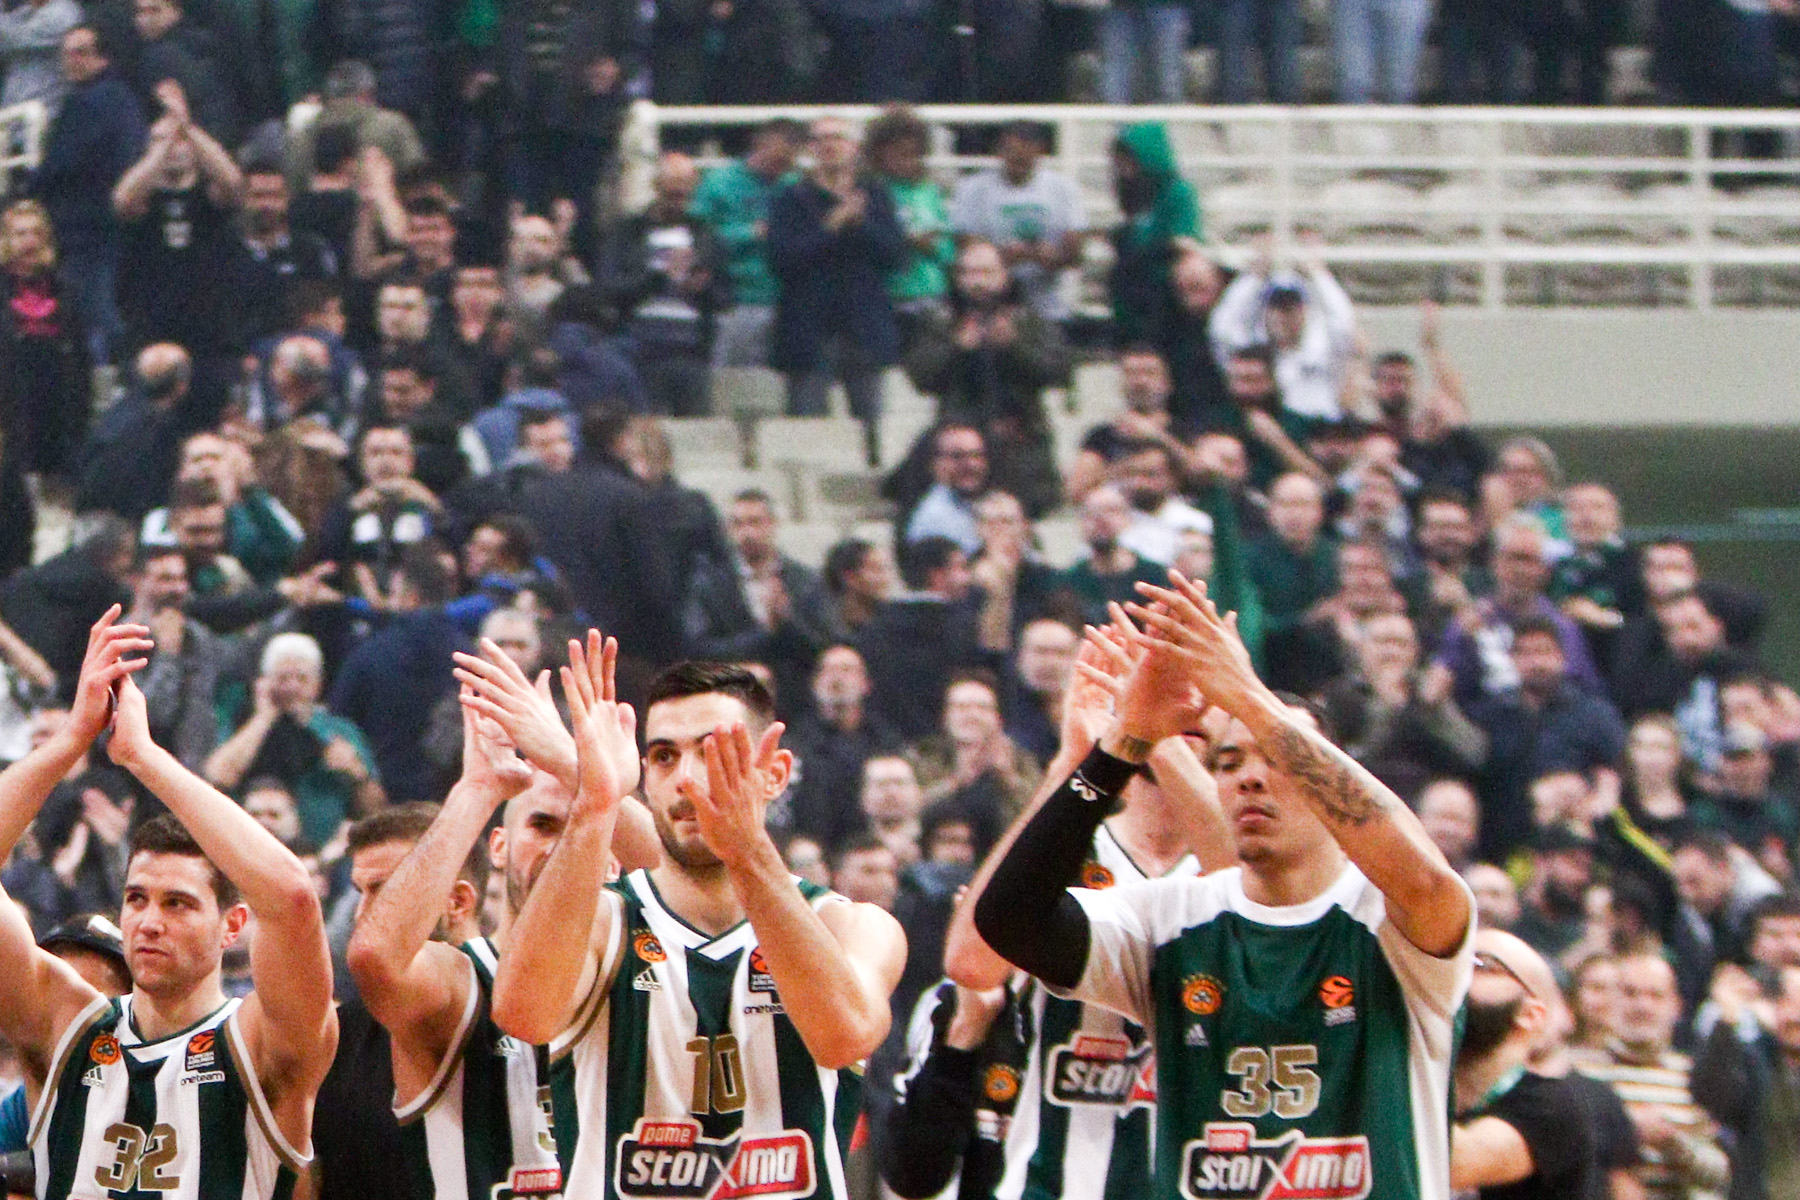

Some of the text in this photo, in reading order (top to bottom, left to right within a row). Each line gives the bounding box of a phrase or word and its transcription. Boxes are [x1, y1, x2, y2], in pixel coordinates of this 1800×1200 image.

[180, 1070, 225, 1087] oneteam
[685, 1034, 749, 1116] 10
[1221, 1044, 1322, 1120] 35
[93, 1122, 181, 1193] 32
